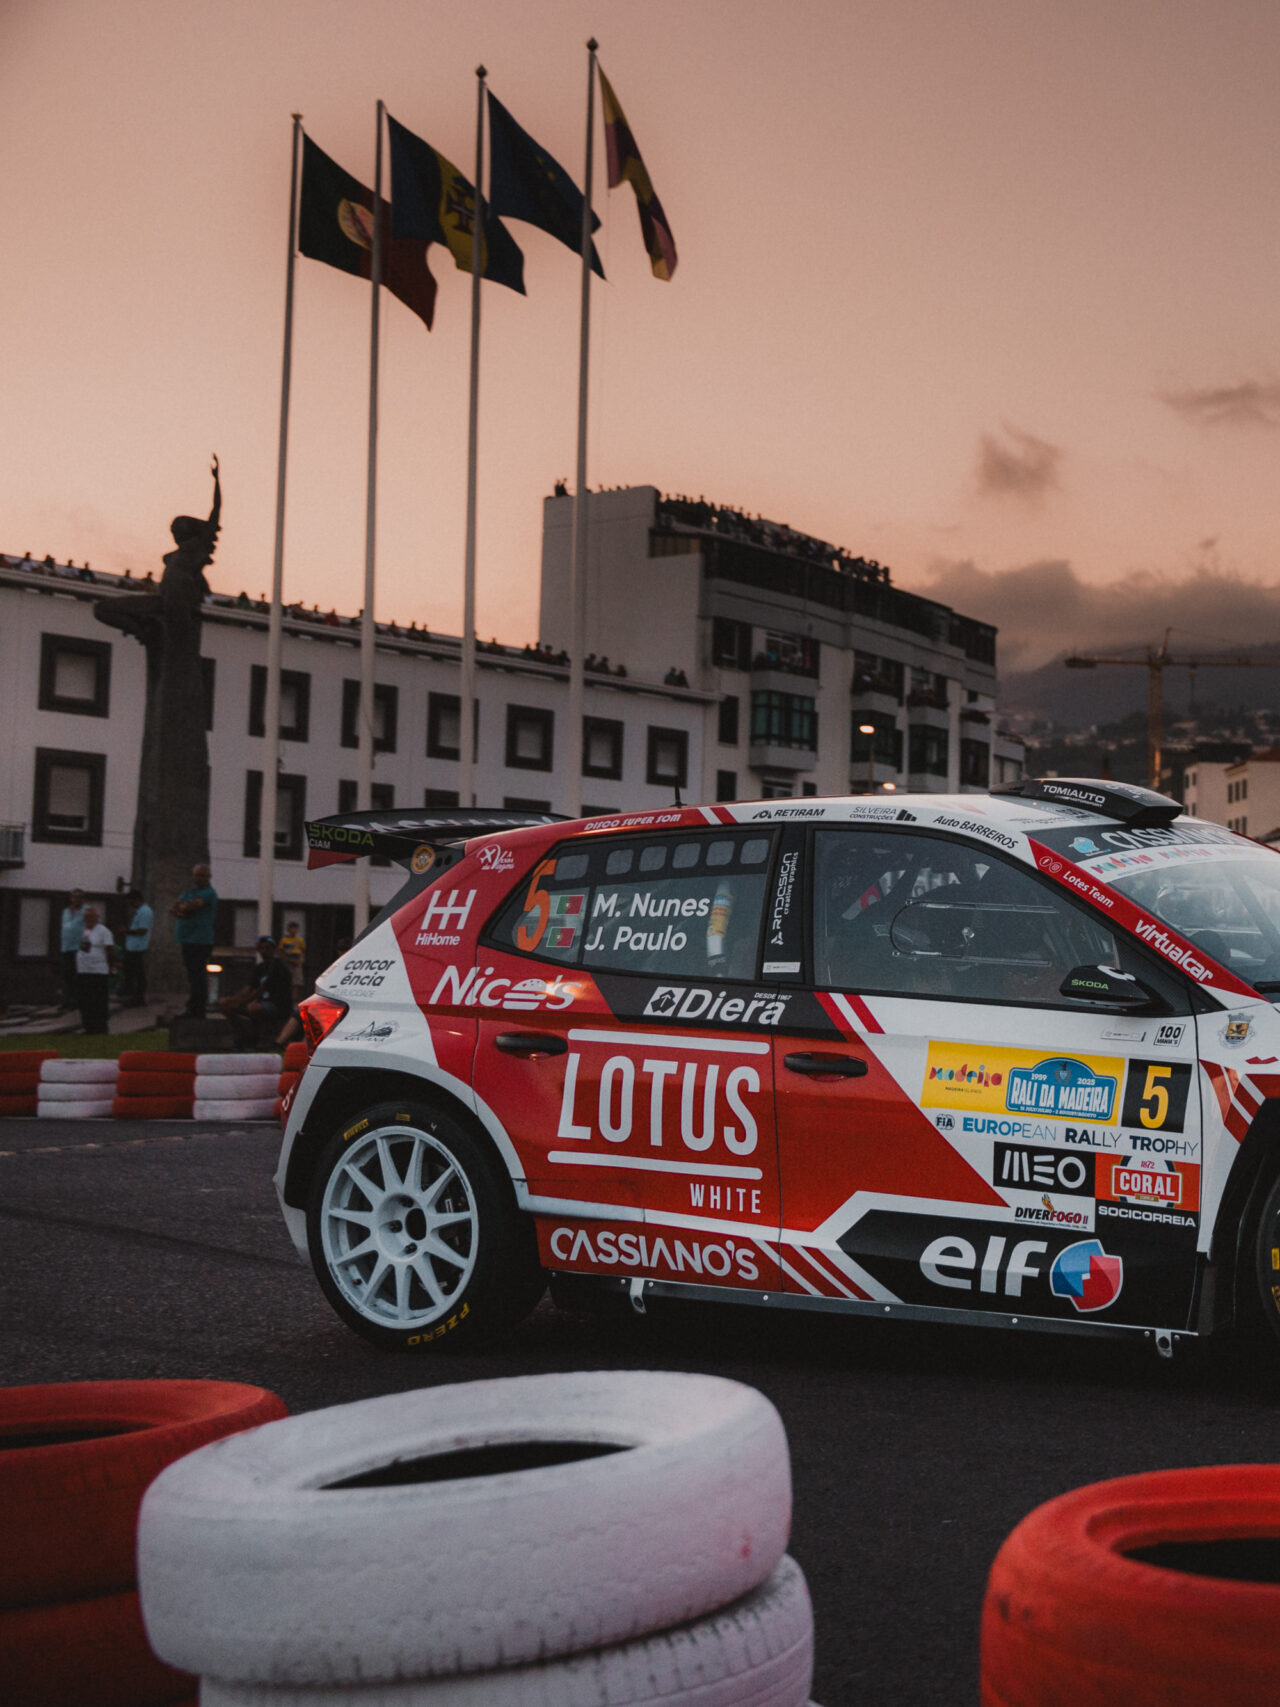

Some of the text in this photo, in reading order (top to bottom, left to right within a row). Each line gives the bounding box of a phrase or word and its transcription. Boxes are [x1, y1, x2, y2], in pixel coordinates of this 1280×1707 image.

[1043, 784, 1106, 804] TOMIAUTO
[584, 813, 681, 831] DISCO SUPER SOM
[774, 808, 826, 818] RETIRAM
[853, 806, 897, 815] SILVEIRA
[309, 838, 331, 850] CIAM
[932, 815, 960, 829] Auto
[959, 820, 1019, 850] BARREIROS
[783, 851, 799, 915] creative graphics
[1062, 870, 1115, 908] Lotes Team
[517, 858, 557, 953] 5
[592, 893, 710, 917] M. Nunes
[415, 932, 461, 946] HiHome
[584, 925, 687, 951] J. Paulo
[1134, 919, 1214, 982] virtualcar
[344, 958, 397, 971] concor
[340, 972, 385, 987] ência
[677, 988, 787, 1026] Diera
[754, 992, 776, 1001] DESDE
[1159, 1025, 1182, 1039] 100
[1031, 1073, 1048, 1082] 1959
[1076, 1077, 1096, 1086] 2025
[556, 1052, 761, 1157] LOTUS
[1010, 1077, 1110, 1114] RALI DA MADEIRA
[1140, 1065, 1172, 1129] 5
[962, 1117, 1200, 1155] EUROPEAN RALLY TROPHY
[1002, 1150, 1087, 1189] MEO
[1119, 1172, 1176, 1197] CORAL
[690, 1182, 761, 1214] WHITE
[1014, 1206, 1081, 1225] DIVERFOGO
[1098, 1205, 1197, 1228] SOCICORREIA
[550, 1227, 760, 1281] CASSIANO'S
[918, 1234, 1049, 1298] elf
